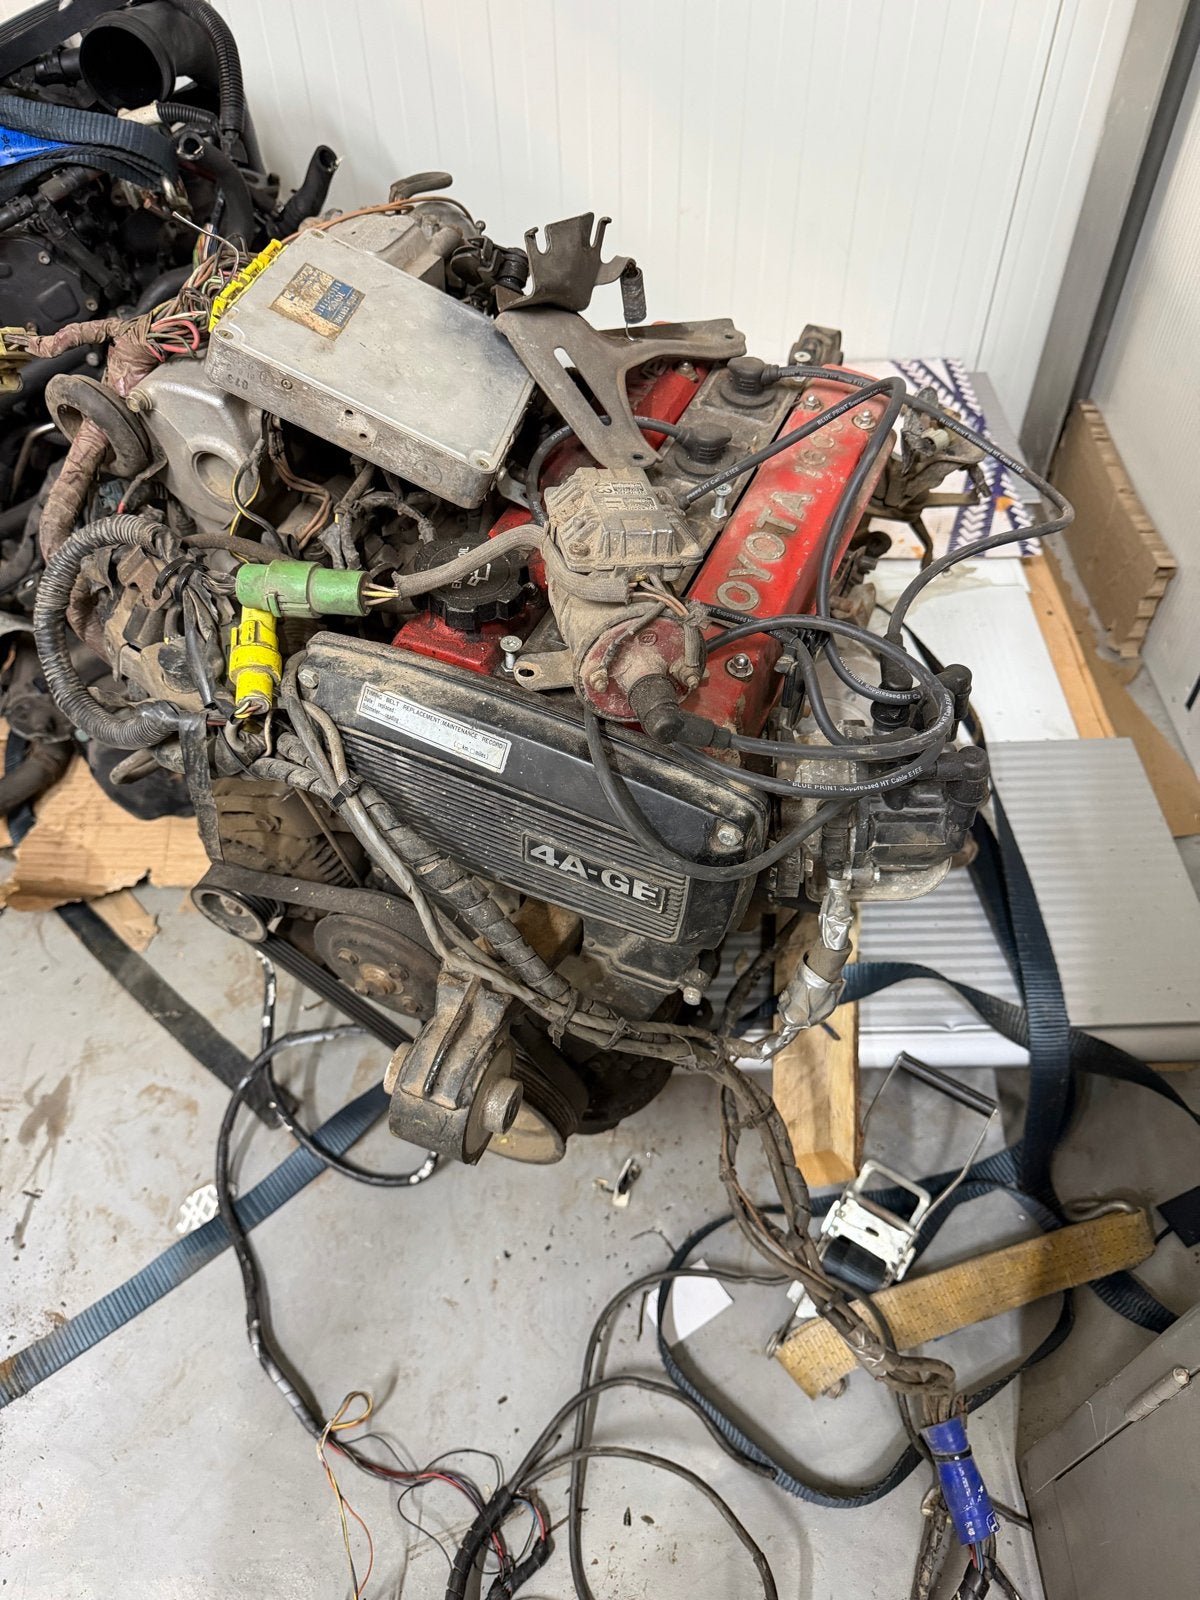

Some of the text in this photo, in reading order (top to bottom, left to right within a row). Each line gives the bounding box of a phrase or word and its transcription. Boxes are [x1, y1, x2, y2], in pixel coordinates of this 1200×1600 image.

[702, 482, 710, 490] HT
[864, 684, 901, 699] Suppressed
[385, 697, 400, 708] BELT
[791, 780, 812, 790] BLUE
[814, 783, 837, 792] PRINT
[840, 781, 880, 793] Suppressed
[880, 779, 890, 788] HT
[890, 773, 908, 785] Cable
[530, 844, 660, 906] 4A-GE
